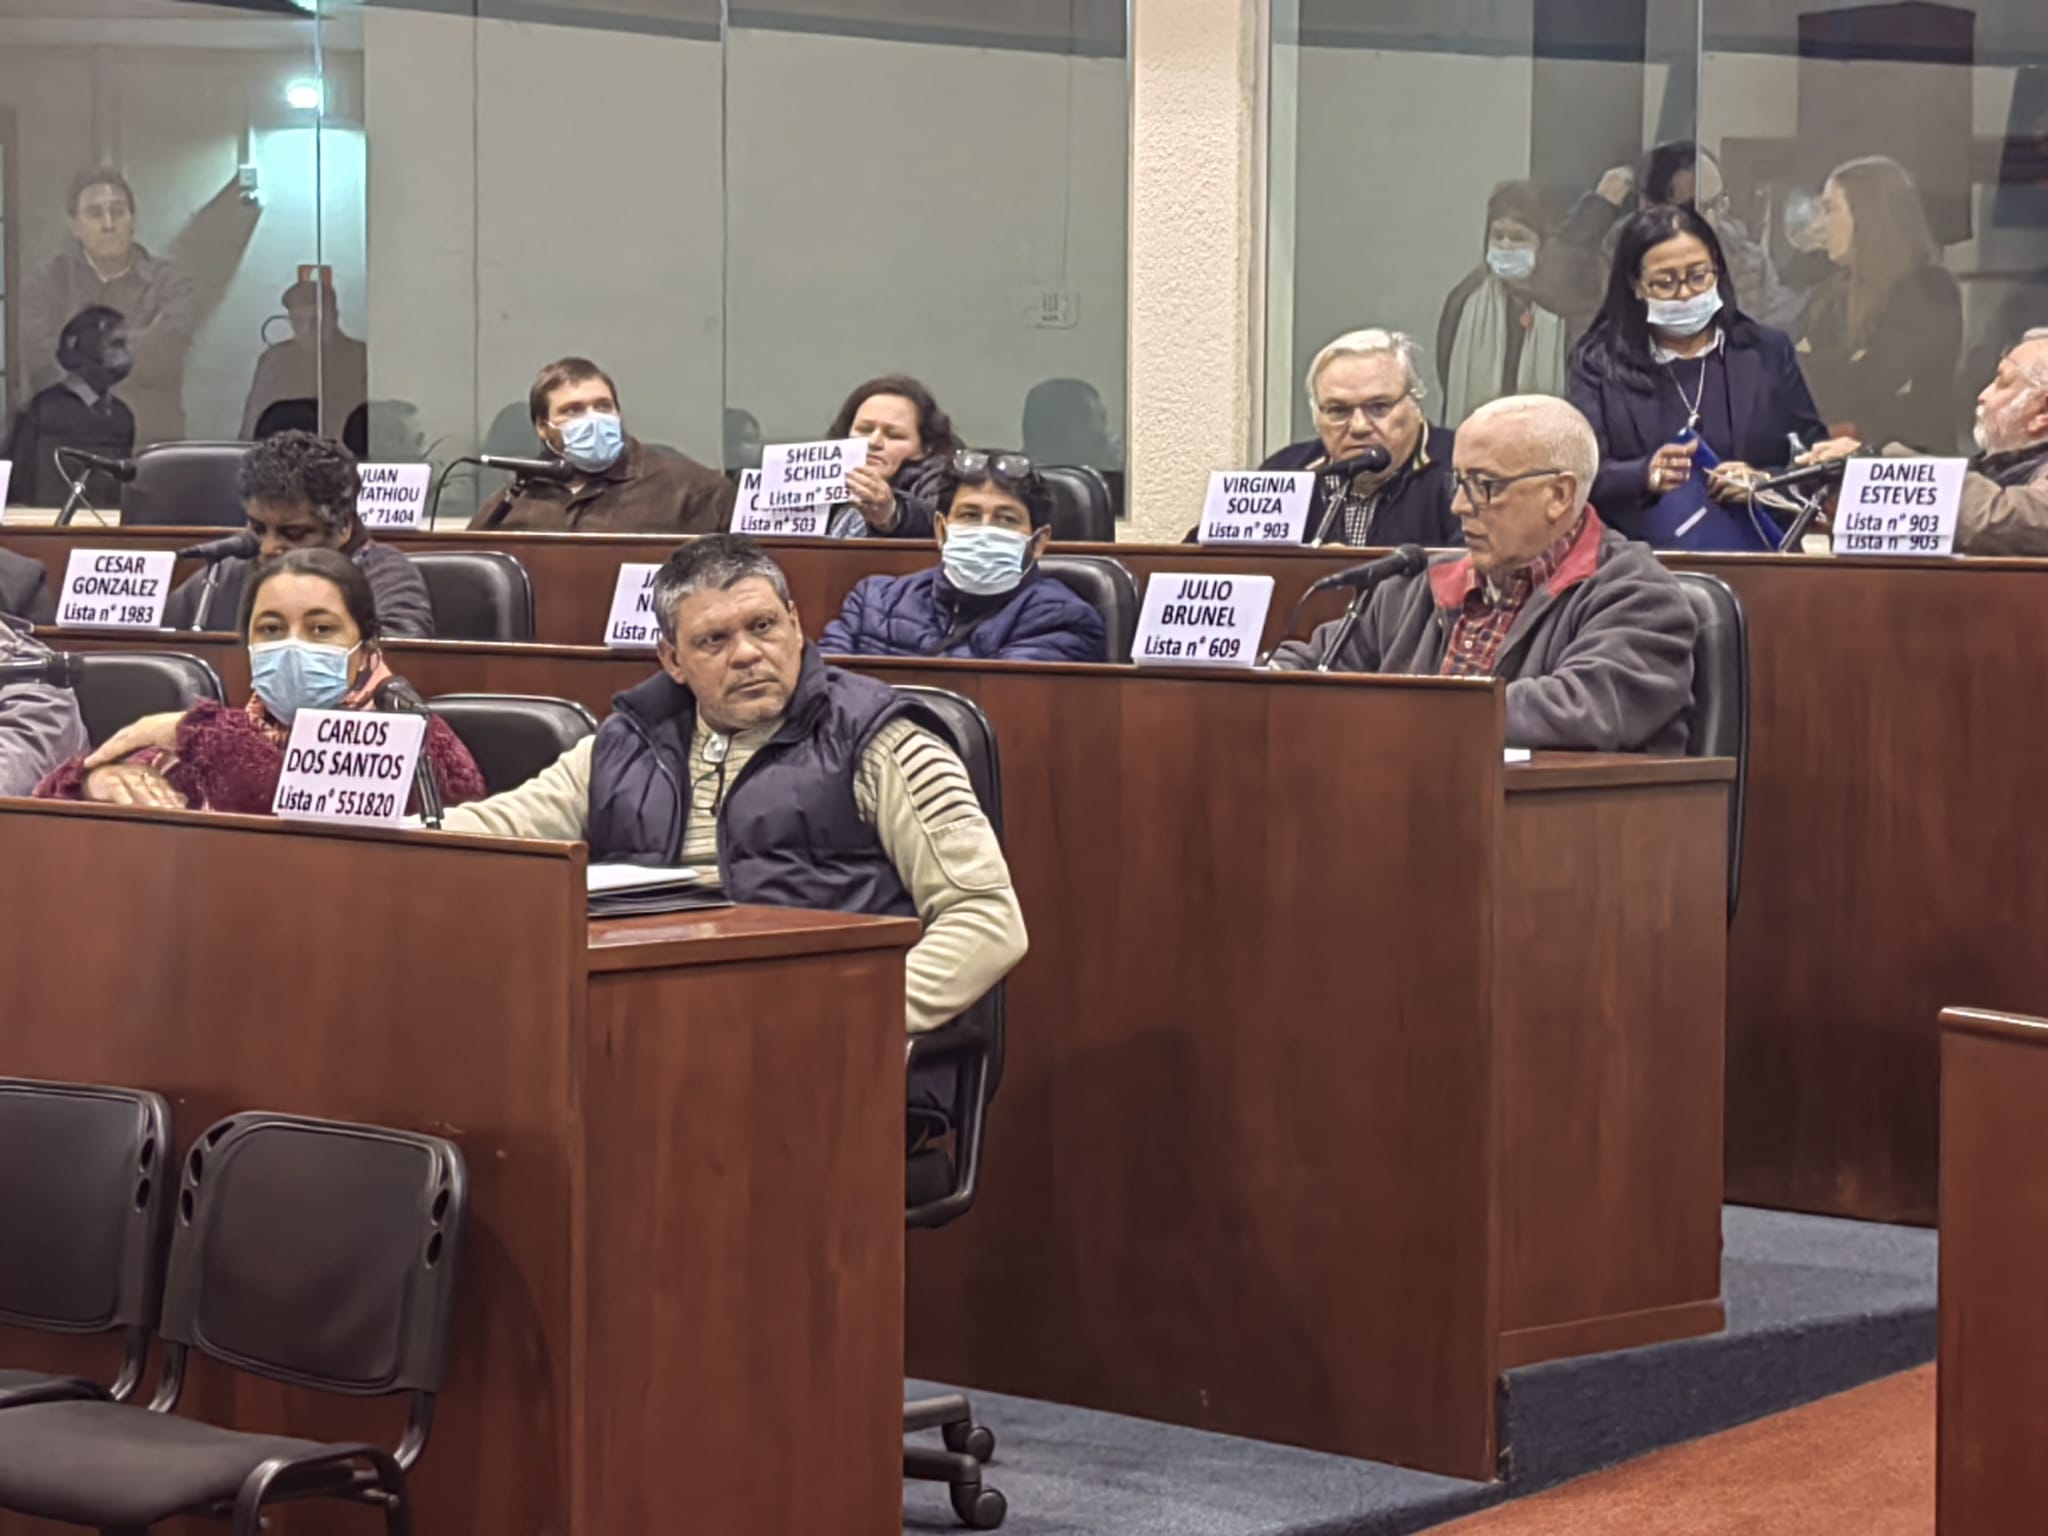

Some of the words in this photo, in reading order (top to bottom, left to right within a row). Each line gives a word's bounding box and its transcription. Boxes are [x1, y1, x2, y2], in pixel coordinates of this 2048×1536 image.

[786, 445, 842, 464] SHEILA
[783, 463, 842, 483] SCHILD
[1869, 463, 1936, 482] DANIEL
[1223, 477, 1296, 494] VIRGINIA
[1860, 485, 1938, 505] ESTEVES
[769, 490, 802, 506] Lista
[824, 486, 850, 501] 503
[1226, 497, 1282, 515] SOUZA
[376, 508, 415, 524] 71404
[740, 516, 771, 531] Lista
[792, 517, 817, 533] 503
[1846, 512, 1882, 531] Lista
[1909, 514, 1939, 533] 903
[1208, 521, 1240, 538] Lista
[1262, 522, 1290, 539] 903
[95, 555, 145, 574] CESAR
[72, 576, 159, 597] GONZALEZ
[1177, 579, 1233, 601] JULIO
[64, 602, 96, 621] Lista
[118, 605, 154, 623] 1983
[1161, 604, 1236, 627] BRUNEL
[612, 621, 647, 640] Lista
[1144, 635, 1182, 656] Lista
[1208, 637, 1241, 658] 609
[318, 718, 390, 747] CARLOS
[286, 748, 327, 775] DOS
[328, 751, 405, 780] SANTOS
[277, 785, 312, 811] Lista
[335, 790, 395, 818] 551820
